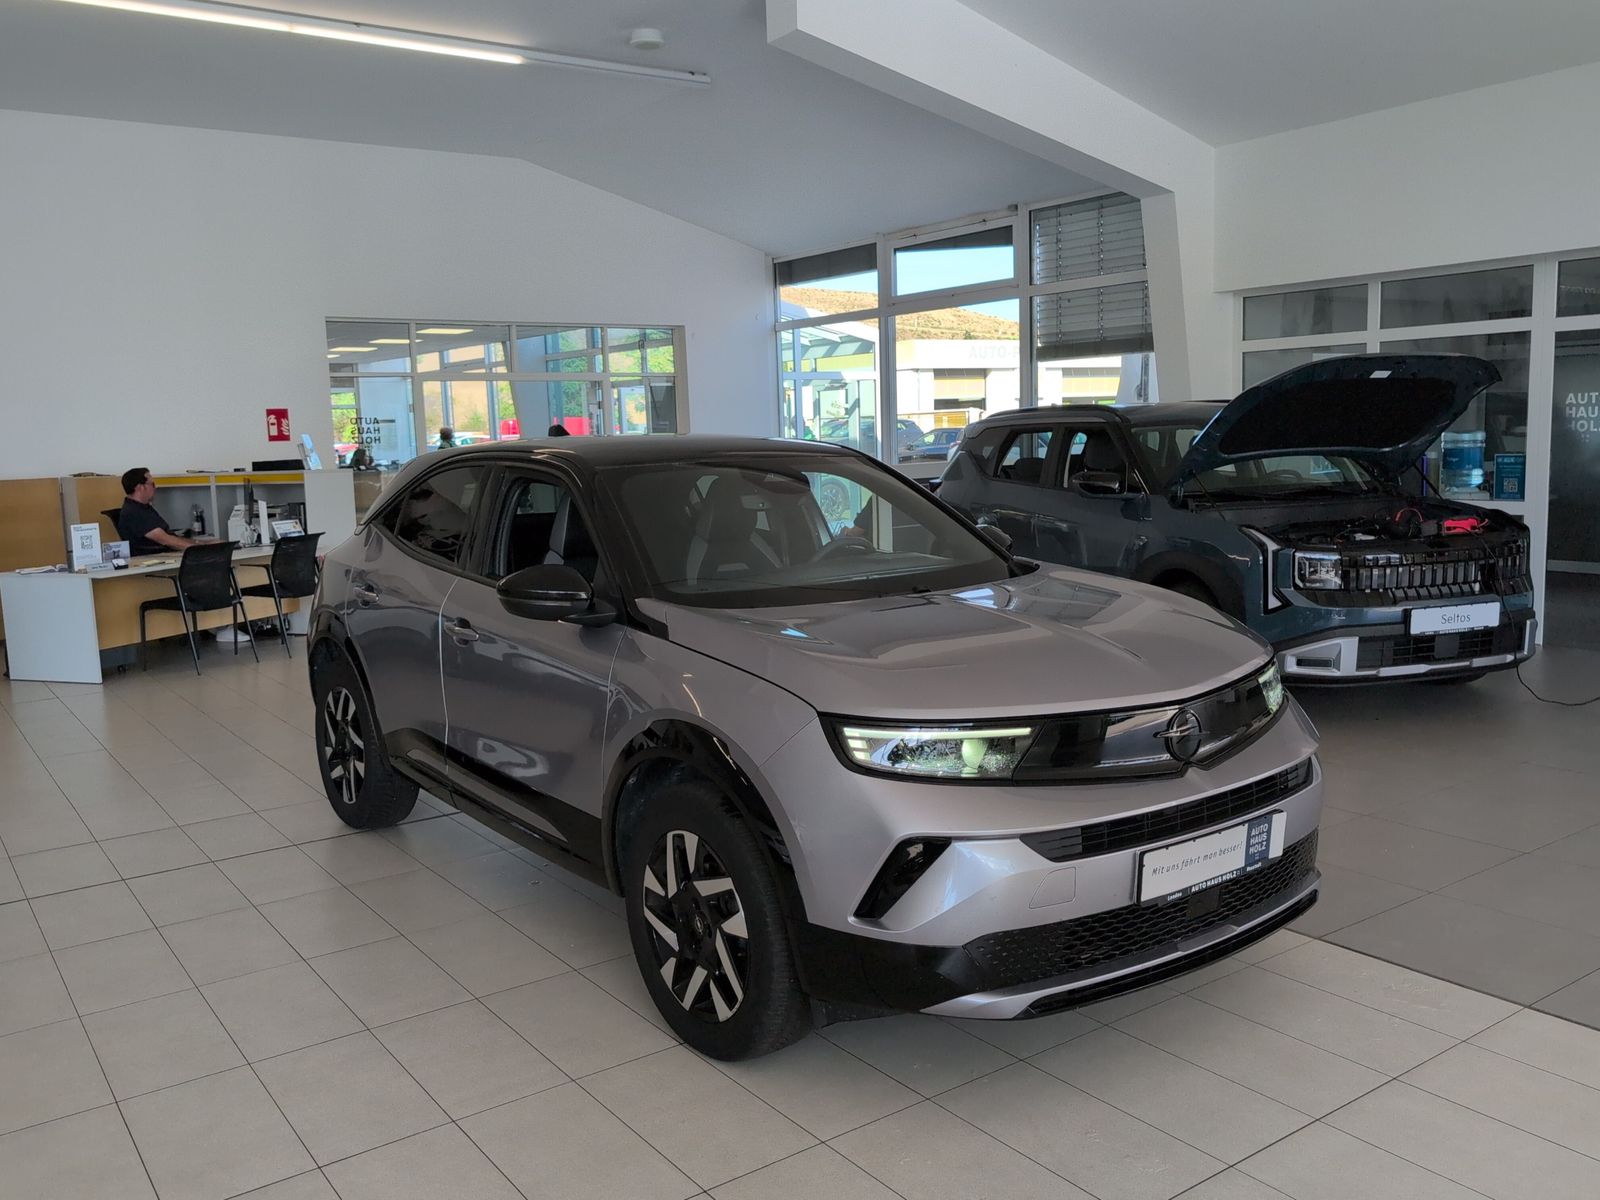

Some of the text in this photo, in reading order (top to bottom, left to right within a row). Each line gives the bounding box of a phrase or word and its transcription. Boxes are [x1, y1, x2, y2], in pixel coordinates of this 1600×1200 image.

[1565, 392, 1600, 404] AUT
[1565, 406, 1600, 418] HAU
[1441, 613, 1471, 625] Seltos
[1251, 823, 1268, 836] AUTO
[1250, 833, 1268, 846] HAUS
[1249, 842, 1267, 855] HOLZ
[1152, 865, 1164, 876] Mit
[1166, 863, 1179, 872] uns
[1202, 852, 1218, 862] man
[1218, 841, 1243, 857] besser!
[1191, 881, 1207, 893] AUTO
[1207, 876, 1222, 886] HAUS
[1222, 870, 1237, 881] HOLZ
